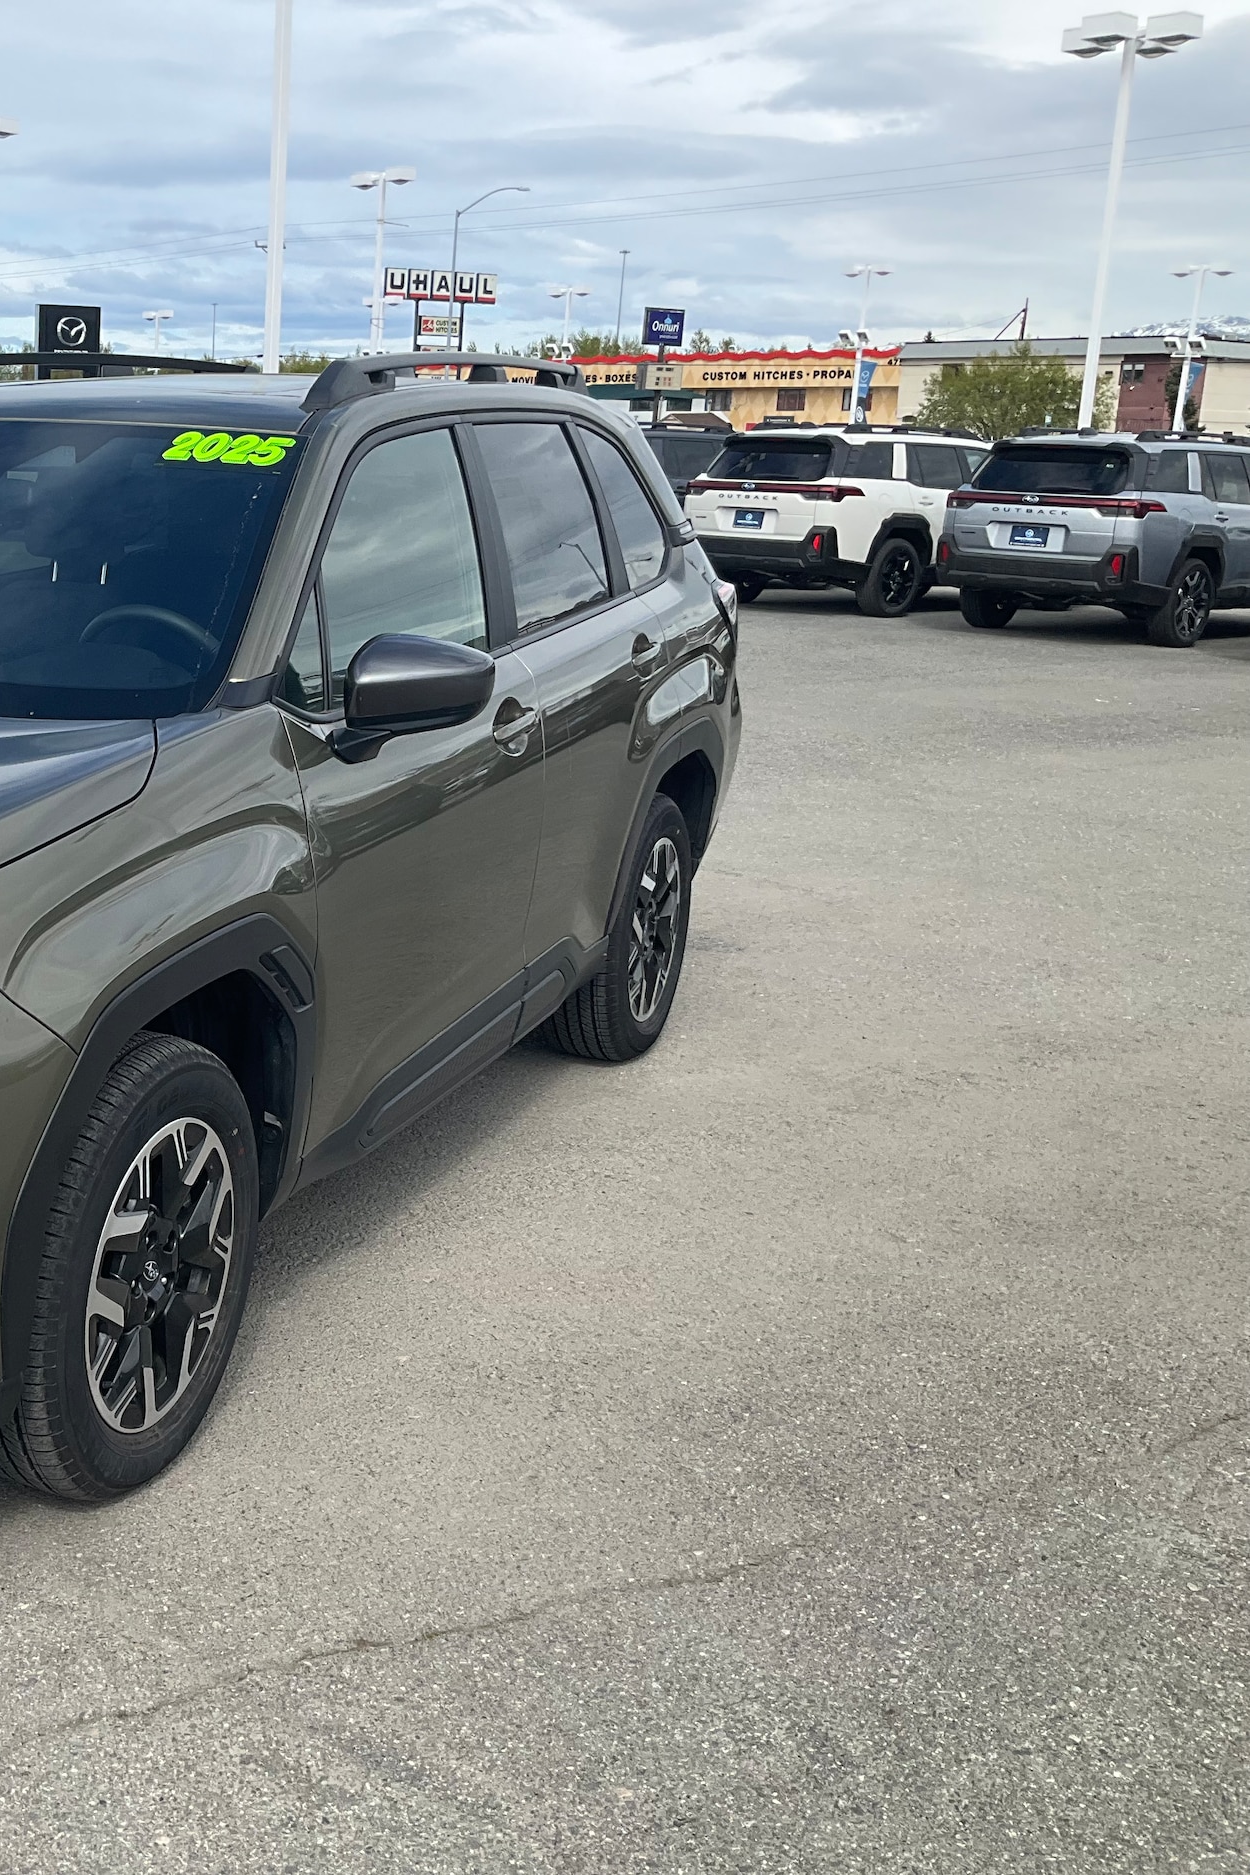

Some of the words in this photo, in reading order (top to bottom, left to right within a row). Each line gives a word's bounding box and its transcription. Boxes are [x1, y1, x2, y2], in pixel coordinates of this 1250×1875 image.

[652, 320, 680, 332] Onnuri
[511, 376, 535, 384] MOVI
[605, 373, 637, 383] BOXES
[702, 371, 747, 381] CUSTOM
[753, 370, 803, 380] HITCHES
[813, 369, 854, 379] PROPA
[162, 431, 296, 466] 2025
[718, 493, 778, 501] OUTBACK
[992, 506, 1069, 516] OUTBACK
